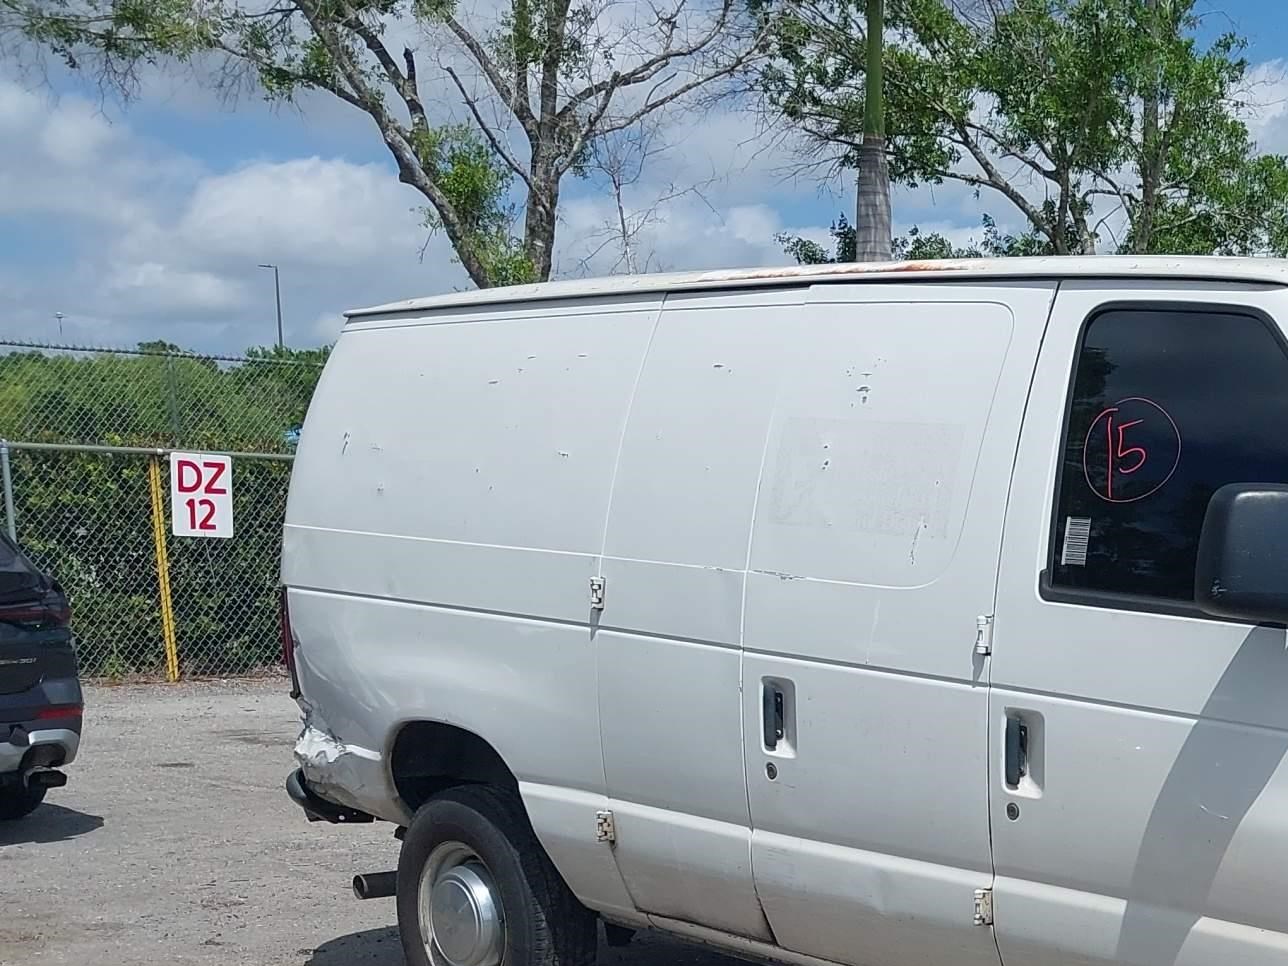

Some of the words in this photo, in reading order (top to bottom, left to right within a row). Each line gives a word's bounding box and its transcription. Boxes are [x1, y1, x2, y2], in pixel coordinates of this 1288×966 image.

[1107, 416, 1147, 499] 15
[177, 460, 227, 494] DZ
[185, 498, 217, 531] 12
